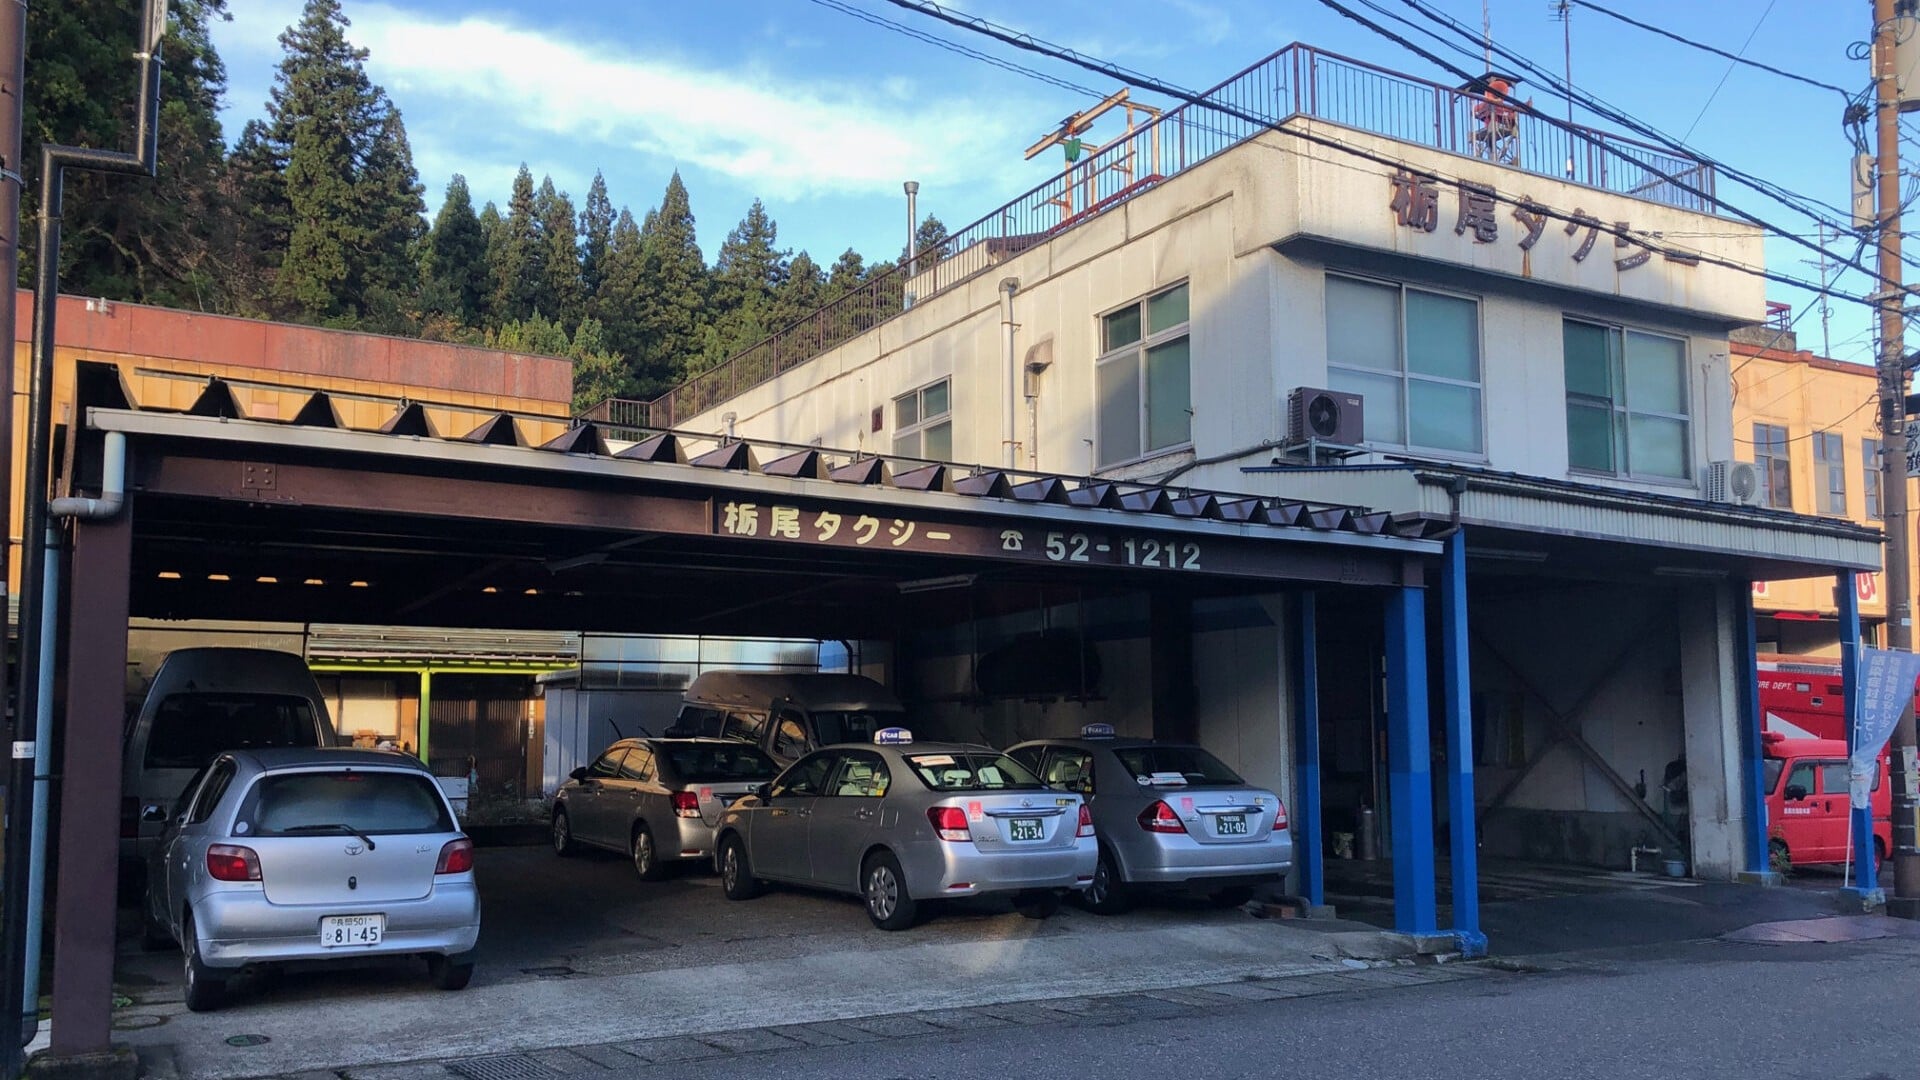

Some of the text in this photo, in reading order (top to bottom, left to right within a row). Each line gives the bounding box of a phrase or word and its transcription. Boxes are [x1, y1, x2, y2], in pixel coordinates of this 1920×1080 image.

[1390, 168, 1700, 271] 栃尾タクシー
[724, 502, 952, 546] 栃尾タクシー
[1046, 532, 1201, 570] 52-1212
[1757, 681, 1770, 689] IRE
[1017, 827, 1043, 839] 21-34
[1223, 822, 1246, 834] 21-02
[335, 926, 378, 943] 81-45
